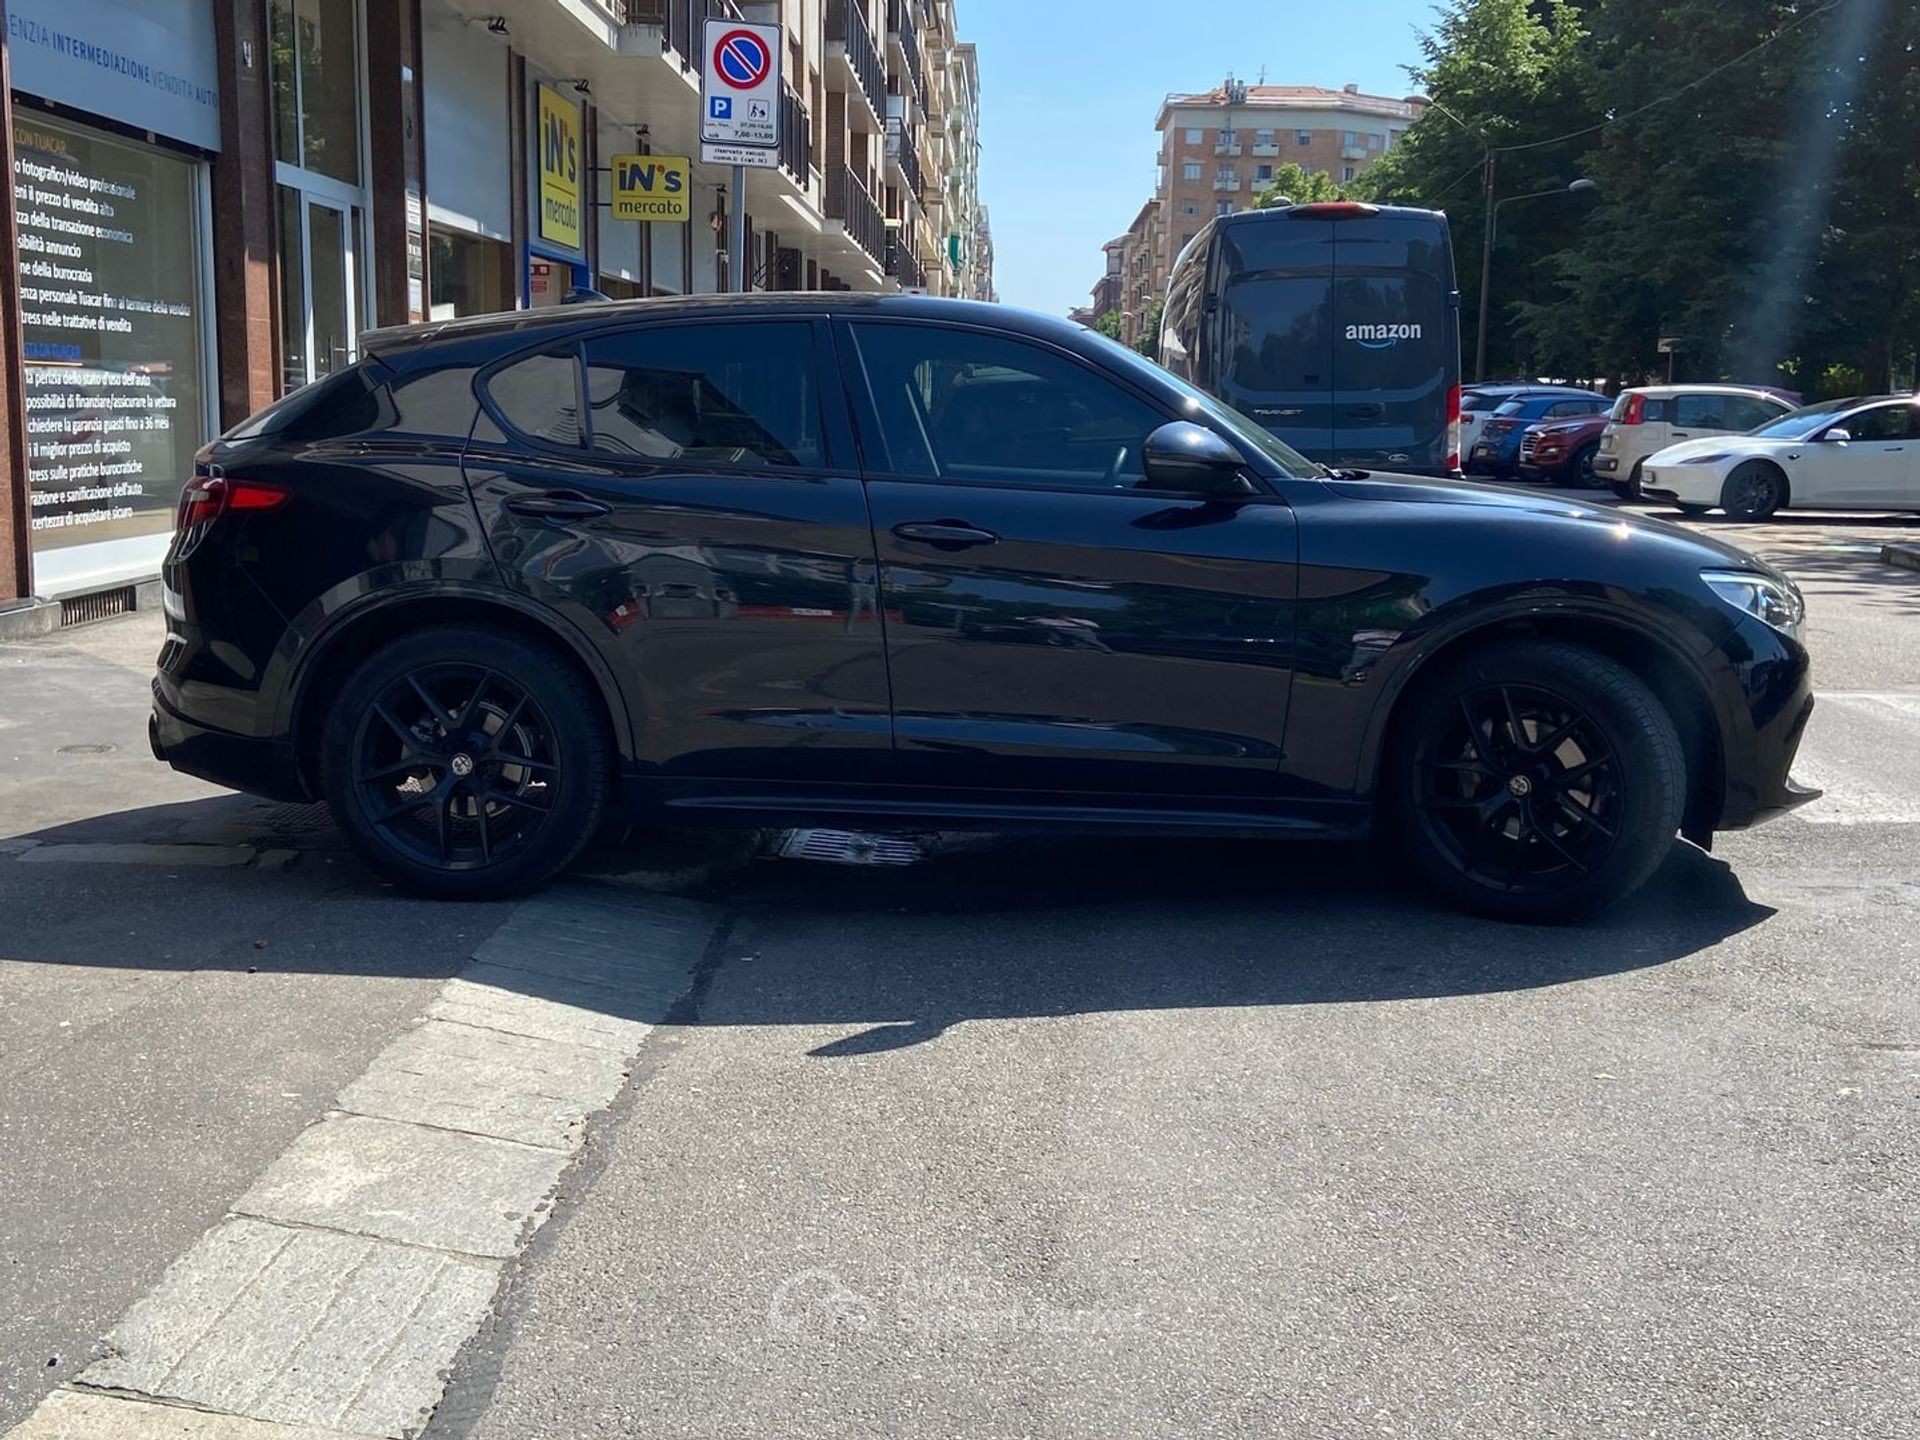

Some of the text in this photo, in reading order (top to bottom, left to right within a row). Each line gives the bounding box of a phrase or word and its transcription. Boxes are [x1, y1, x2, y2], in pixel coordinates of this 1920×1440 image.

[10, 14, 218, 108] ENZIA INTERMEDIAZIONE VENDITA AUTO
[715, 100, 727, 116] P
[28, 185, 34, 200] il
[36, 190, 61, 205] prezzo
[62, 193, 70, 208] di
[71, 198, 98, 214] vendita
[90, 178, 136, 200] professionale
[546, 197, 576, 230] mercato
[618, 200, 682, 215] mercato
[31, 210, 50, 229] della
[51, 215, 95, 236] transazione
[96, 226, 133, 244] economica
[46, 240, 81, 258] annuncio
[32, 260, 52, 278] della
[53, 263, 92, 282] burocrazia
[39, 288, 77, 304] personale
[77, 290, 102, 307] Tuacar
[103, 293, 116, 308] fino
[119, 296, 125, 309] al
[126, 299, 152, 312] termine
[153, 300, 168, 314] della
[169, 303, 191, 316] vendita
[42, 310, 61, 327] nelle
[63, 314, 96, 330] trattative
[98, 316, 105, 330] di
[106, 317, 132, 332] vendita
[1345, 324, 1422, 340] amazon
[122, 372, 150, 386] dell'auto
[26, 394, 65, 412] possibilità
[67, 394, 74, 409] di
[147, 394, 153, 408] la
[154, 396, 177, 408] vettura
[64, 417, 71, 432] la
[72, 417, 102, 435] garanzia
[104, 417, 124, 434] guasti
[126, 416, 138, 430] fino
[140, 420, 144, 430] a
[145, 416, 153, 430] 36
[155, 416, 169, 429] mesi
[33, 442, 39, 457] il
[40, 442, 67, 460] miglior
[69, 442, 93, 459] prezzo
[94, 439, 101, 454] di
[102, 440, 131, 456] acquisto
[50, 464, 68, 480] sulle
[69, 462, 100, 482] pratiche
[100, 460, 142, 476] burocratiche
[60, 492, 65, 503] e
[67, 486, 113, 502] sanificazione
[113, 482, 142, 497] dell'auto
[32, 506, 133, 530] certezza di acquistare sicuro
